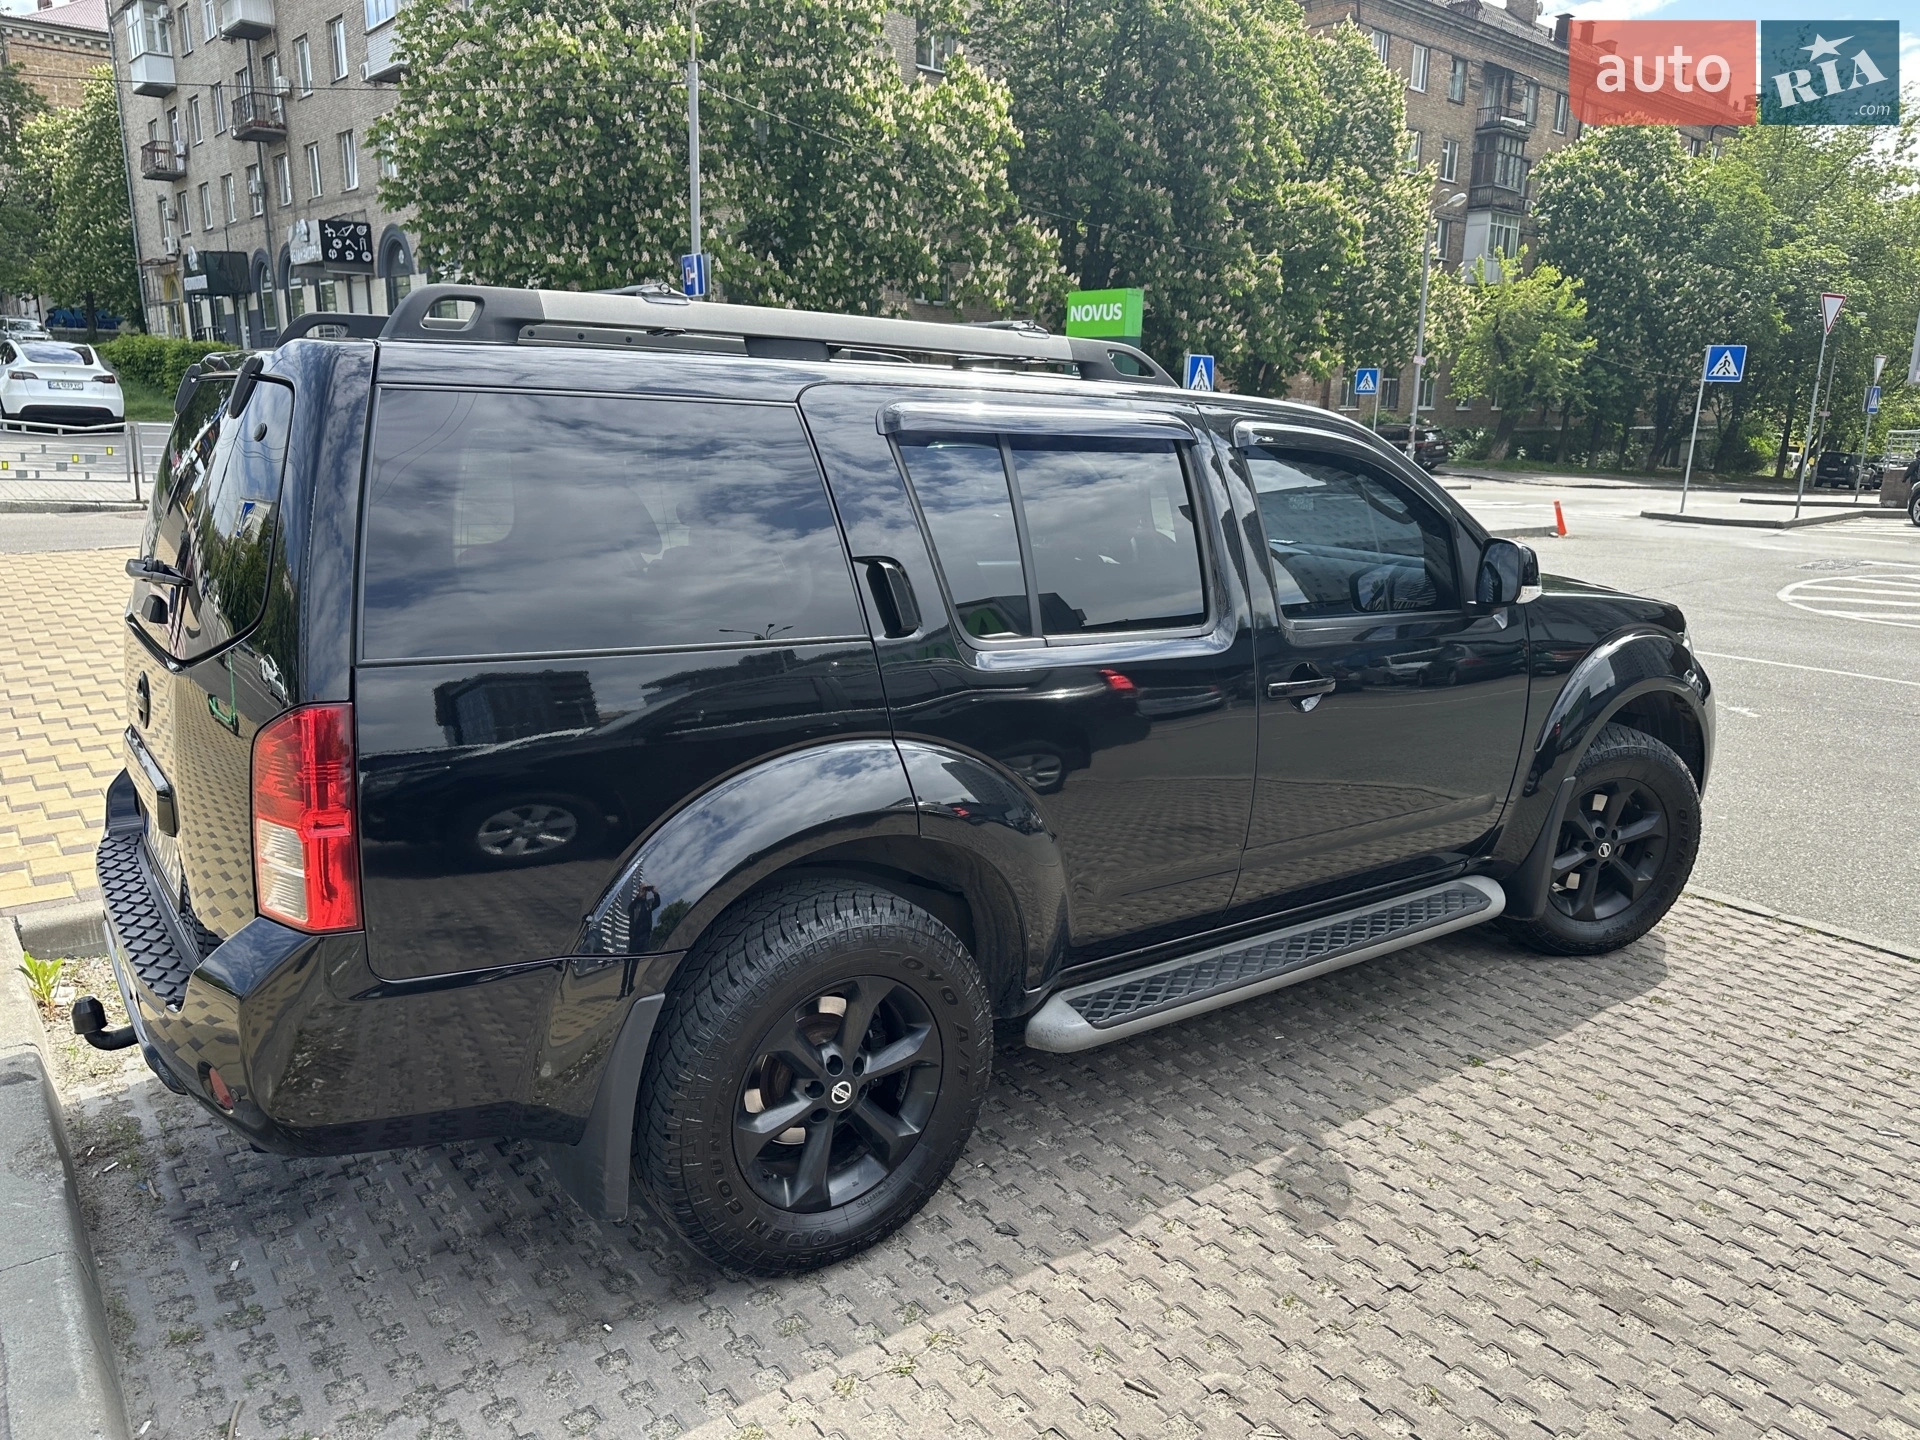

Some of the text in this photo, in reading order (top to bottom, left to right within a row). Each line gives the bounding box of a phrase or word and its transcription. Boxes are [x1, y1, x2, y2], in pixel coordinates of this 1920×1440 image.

[1069, 302, 1123, 322] NOVUS
[880, 951, 959, 1006] TOYO
[746, 1216, 835, 1249] OPEN
